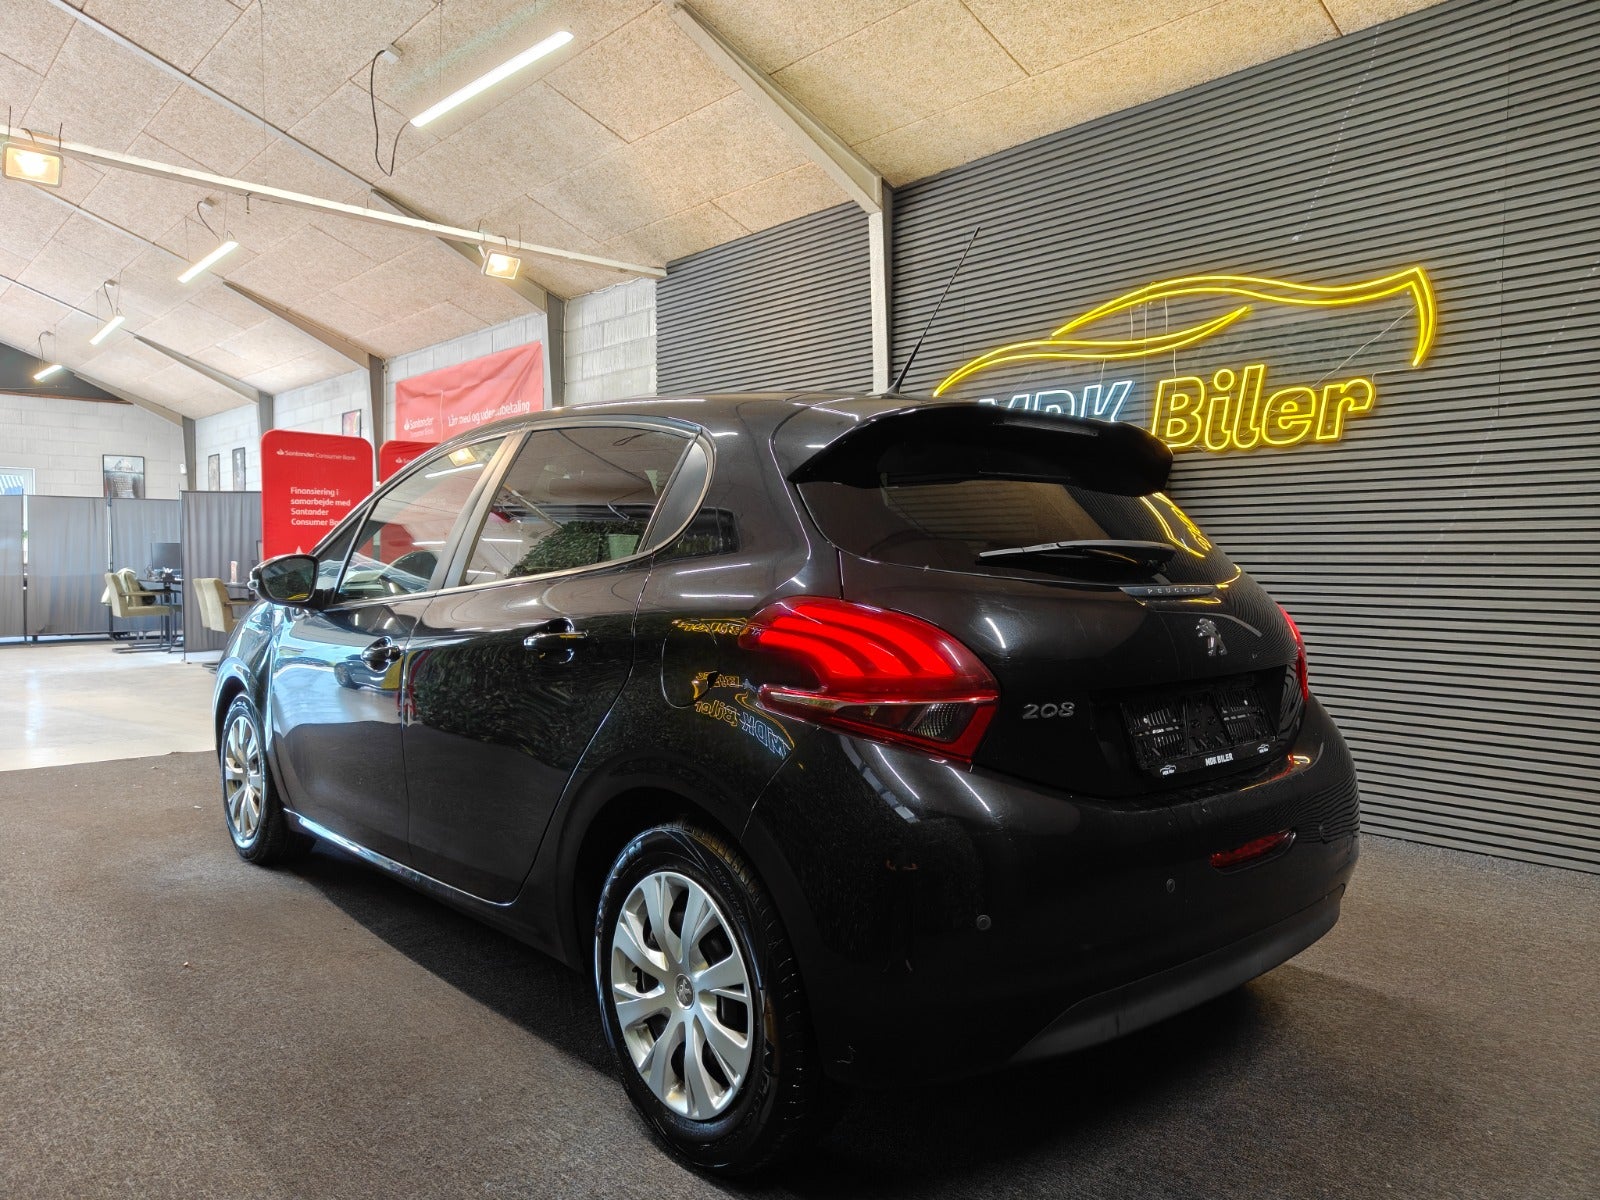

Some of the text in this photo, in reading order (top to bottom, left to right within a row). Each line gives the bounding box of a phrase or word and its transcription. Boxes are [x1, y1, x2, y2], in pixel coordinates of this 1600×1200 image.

[1150, 364, 1374, 451] Biler
[285, 450, 315, 458] Santander
[290, 487, 335, 497] Finansiering
[290, 498, 334, 507] samarbejde
[291, 508, 329, 516] Santander
[291, 518, 328, 526] Consumer
[1022, 702, 1075, 720] 208
[1218, 752, 1234, 764] BILER
